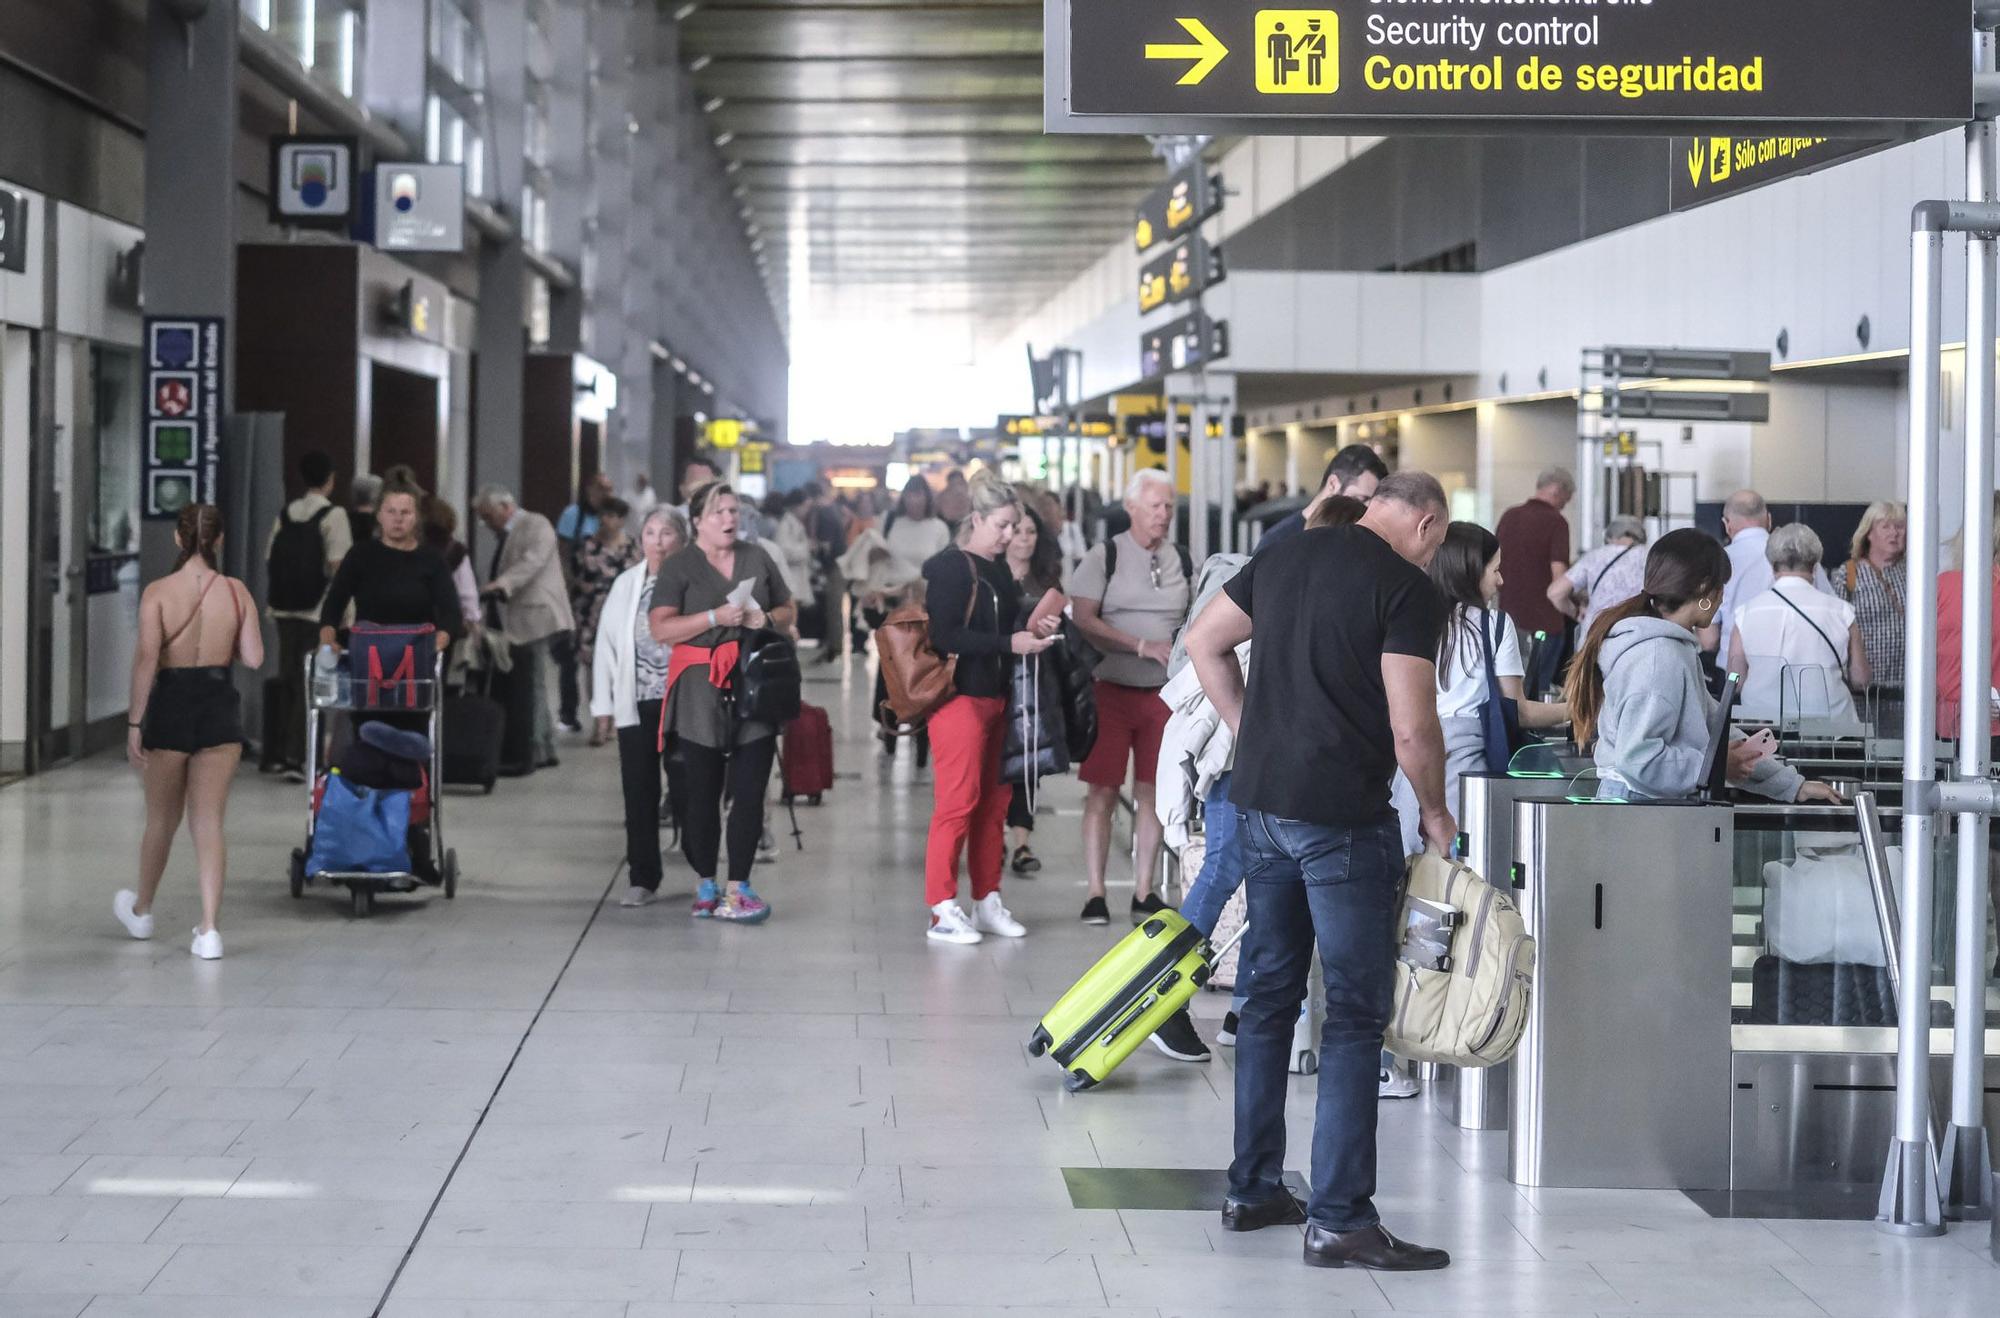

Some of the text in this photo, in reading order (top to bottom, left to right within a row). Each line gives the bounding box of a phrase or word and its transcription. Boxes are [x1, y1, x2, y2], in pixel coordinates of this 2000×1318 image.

[1366, 14, 1599, 51] Security control
[1364, 54, 1763, 98] Control de seguridad
[1735, 139, 1756, 171] Sólo
[1758, 137, 1776, 163] con
